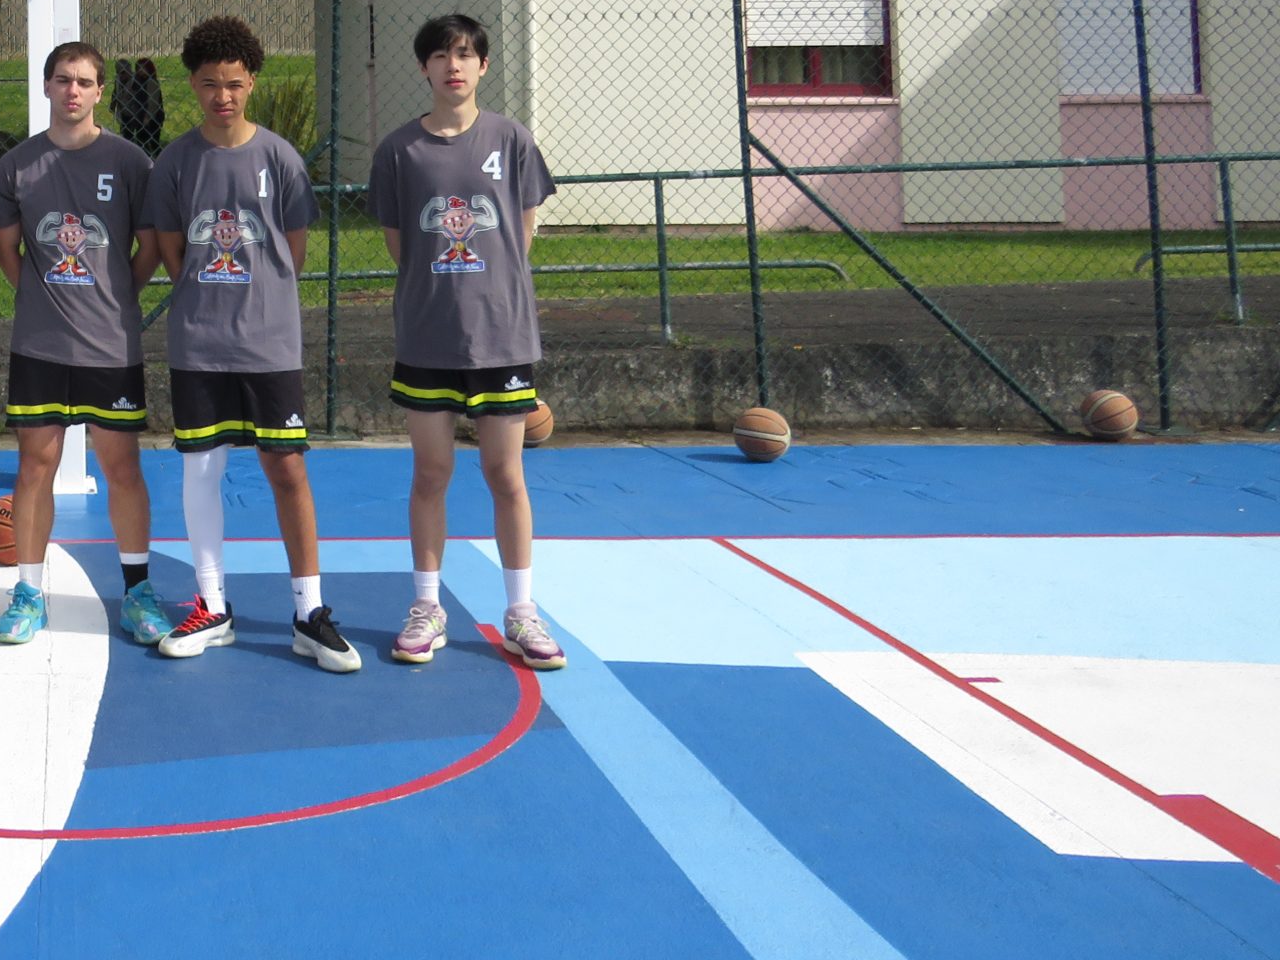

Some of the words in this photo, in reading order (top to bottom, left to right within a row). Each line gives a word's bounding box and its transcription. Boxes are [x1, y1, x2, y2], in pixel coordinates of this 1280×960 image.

[481, 151, 502, 180] 4
[97, 174, 114, 201] 5
[258, 168, 268, 198] 1
